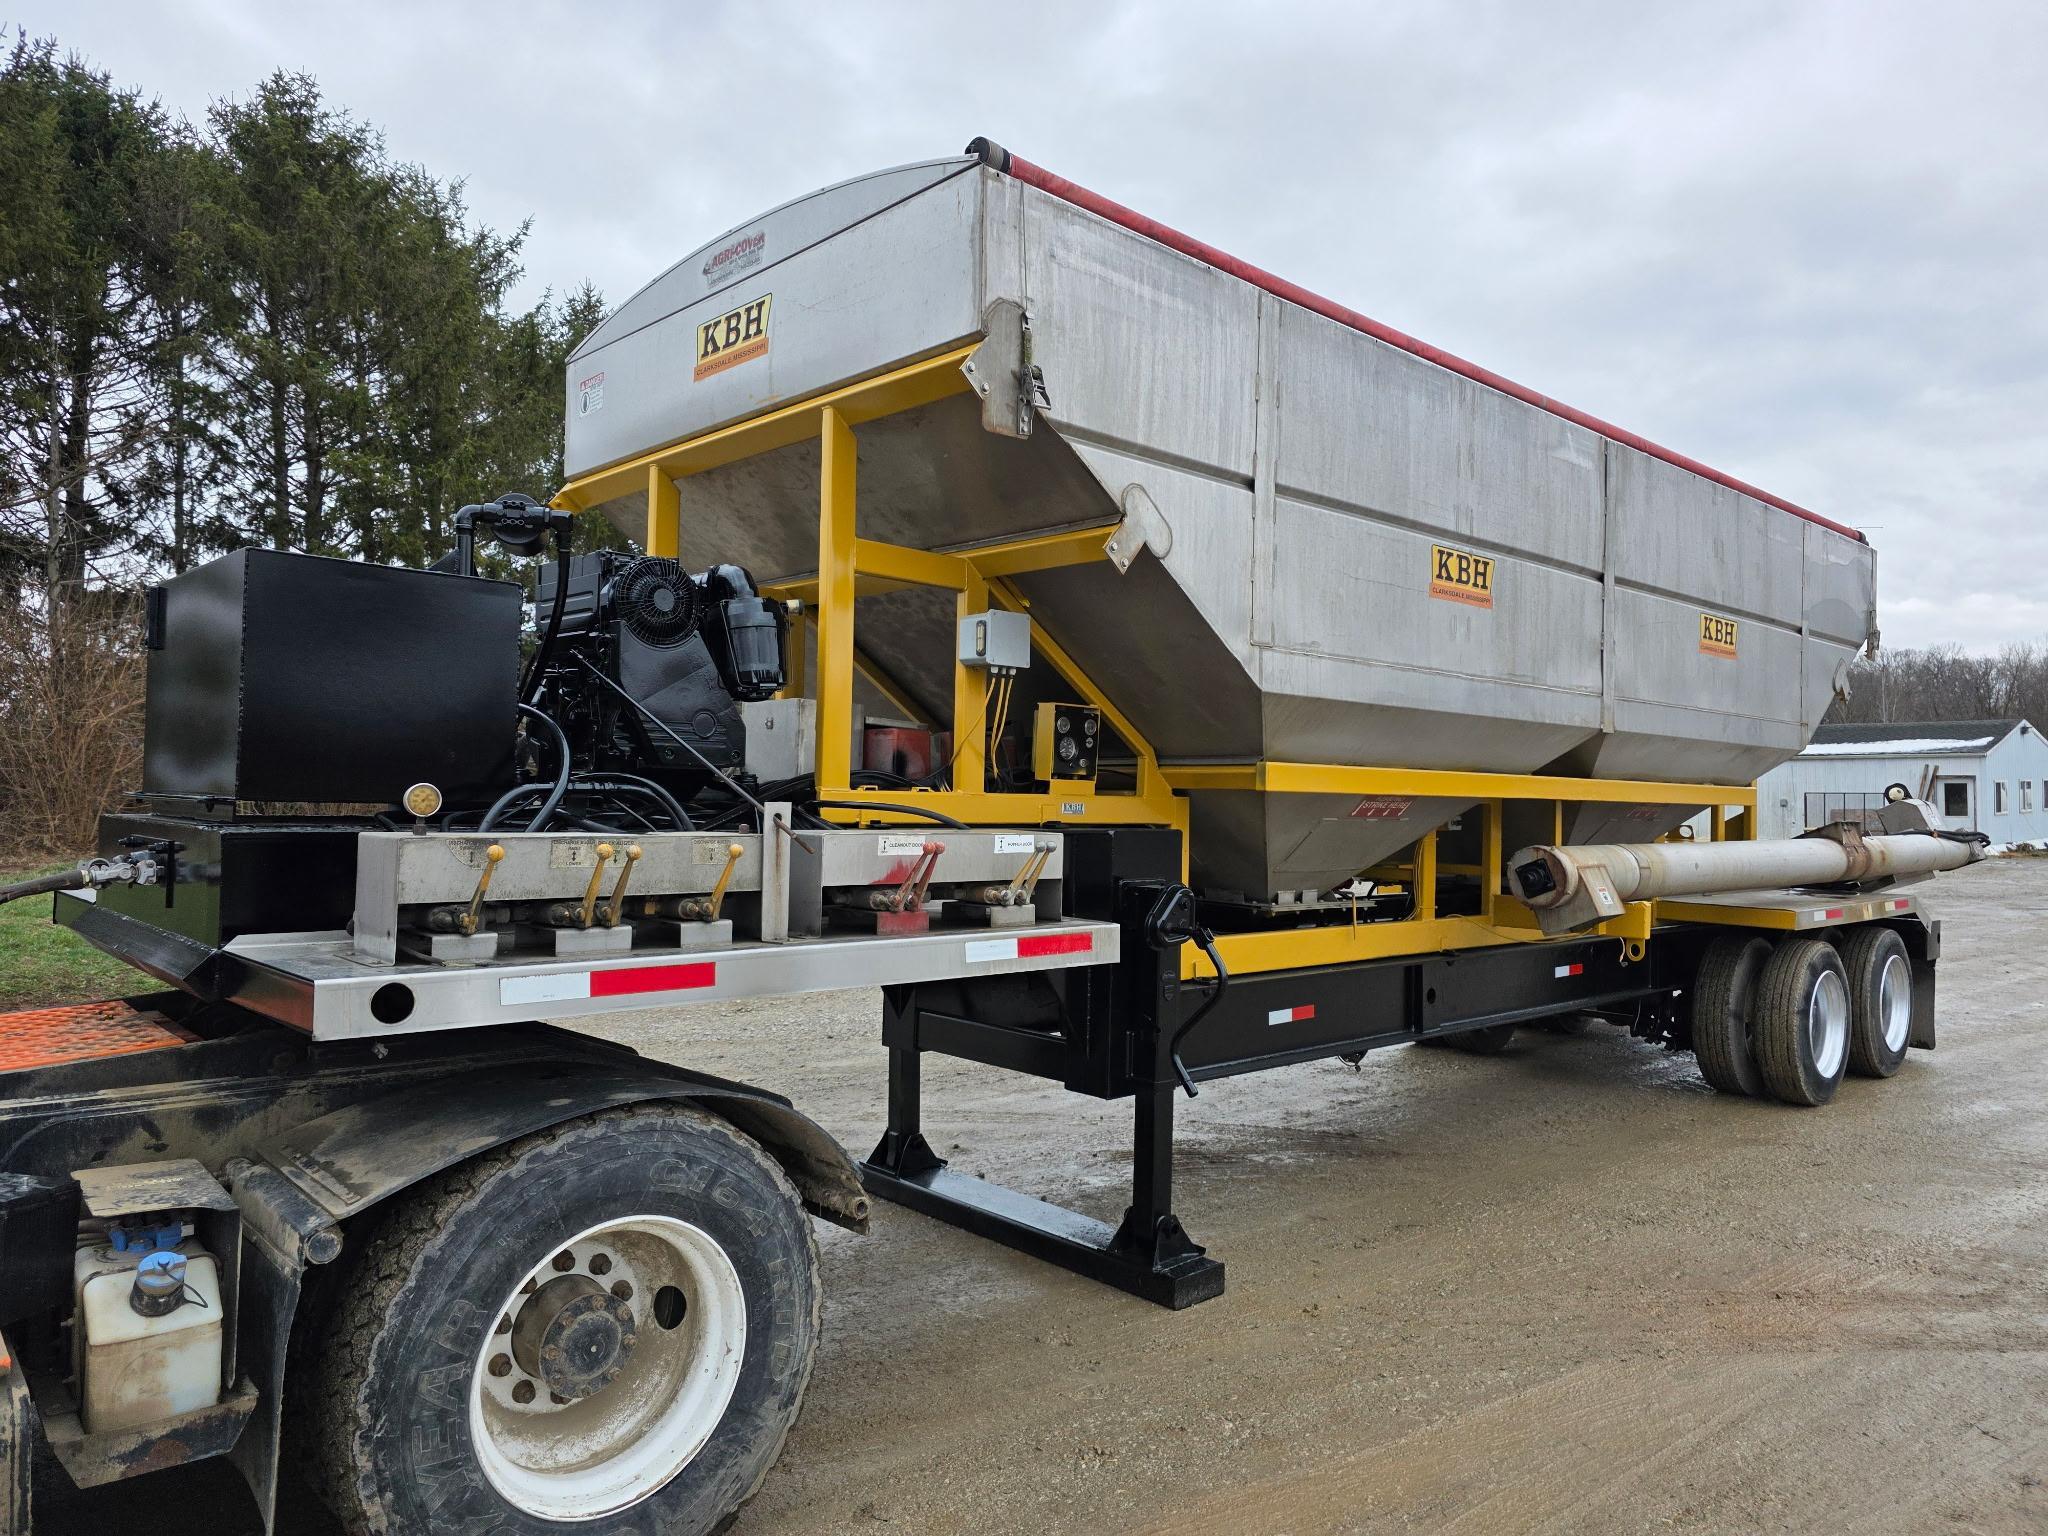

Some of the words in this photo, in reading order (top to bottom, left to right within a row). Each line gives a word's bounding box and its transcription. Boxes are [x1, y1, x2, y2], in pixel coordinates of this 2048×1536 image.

[701, 299, 766, 358] KBH
[696, 356, 733, 376] CLARKSDALE
[733, 341, 766, 361] MISSISSIPPI
[1436, 549, 1490, 589] KBH
[1432, 586, 1465, 599] CLARKSDALE
[1703, 616, 1734, 645] KBH
[1065, 802, 1082, 811] KBH
